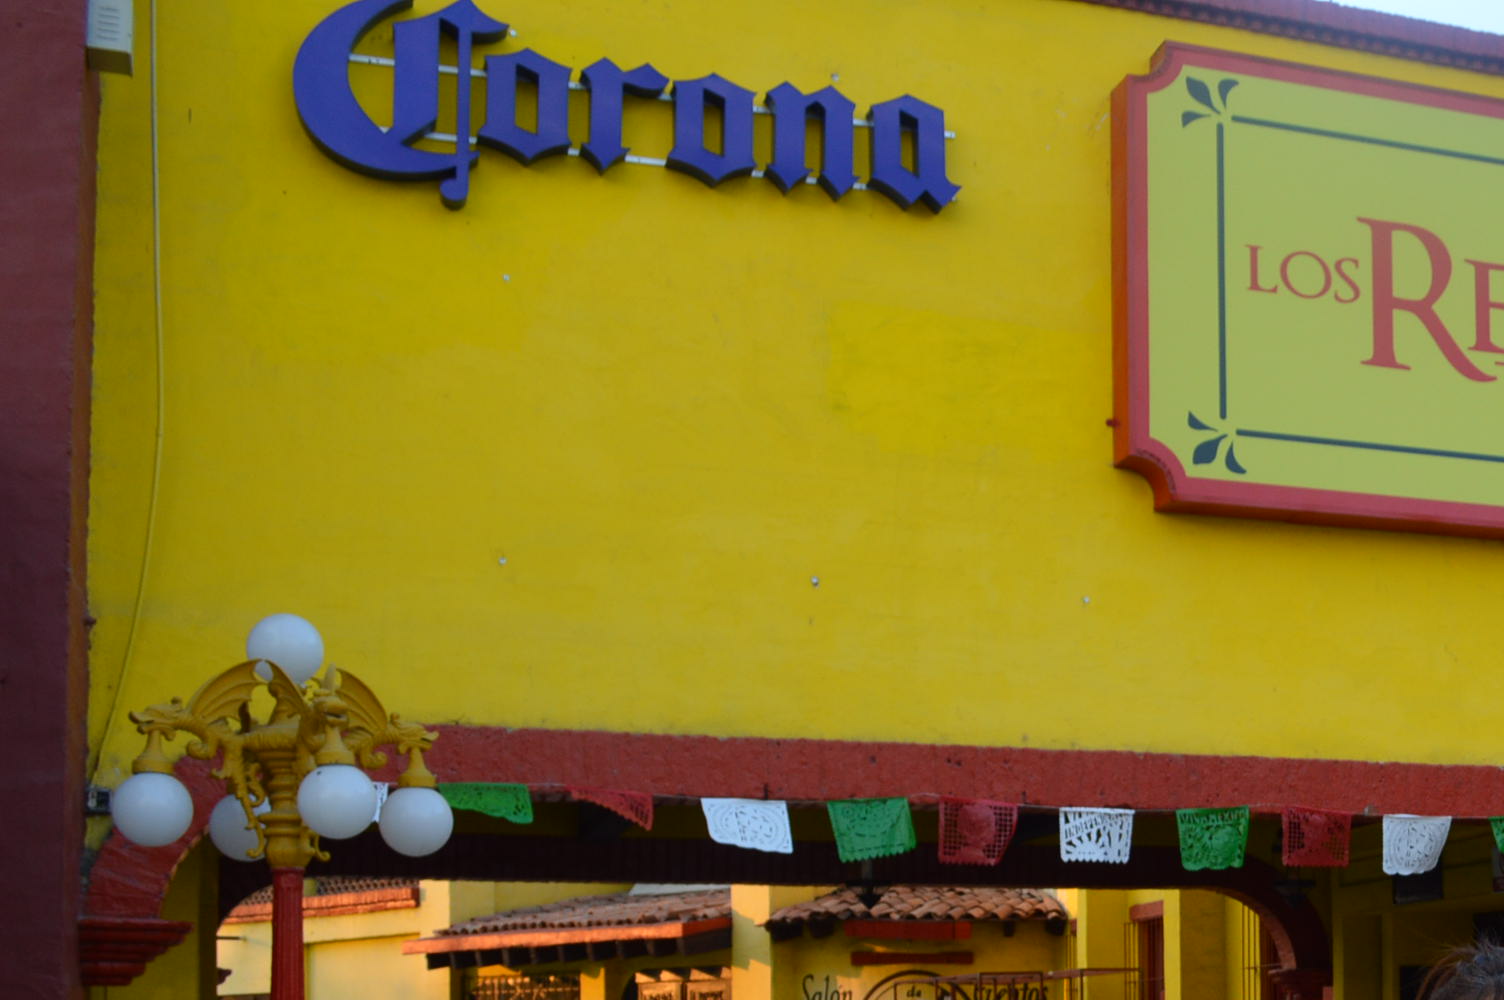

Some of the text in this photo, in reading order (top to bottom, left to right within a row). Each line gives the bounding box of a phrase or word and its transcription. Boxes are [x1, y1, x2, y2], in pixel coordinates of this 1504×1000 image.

[293, 0, 961, 214] Corona
[1245, 244, 1361, 304] LOS
[906, 985, 922, 998] de
